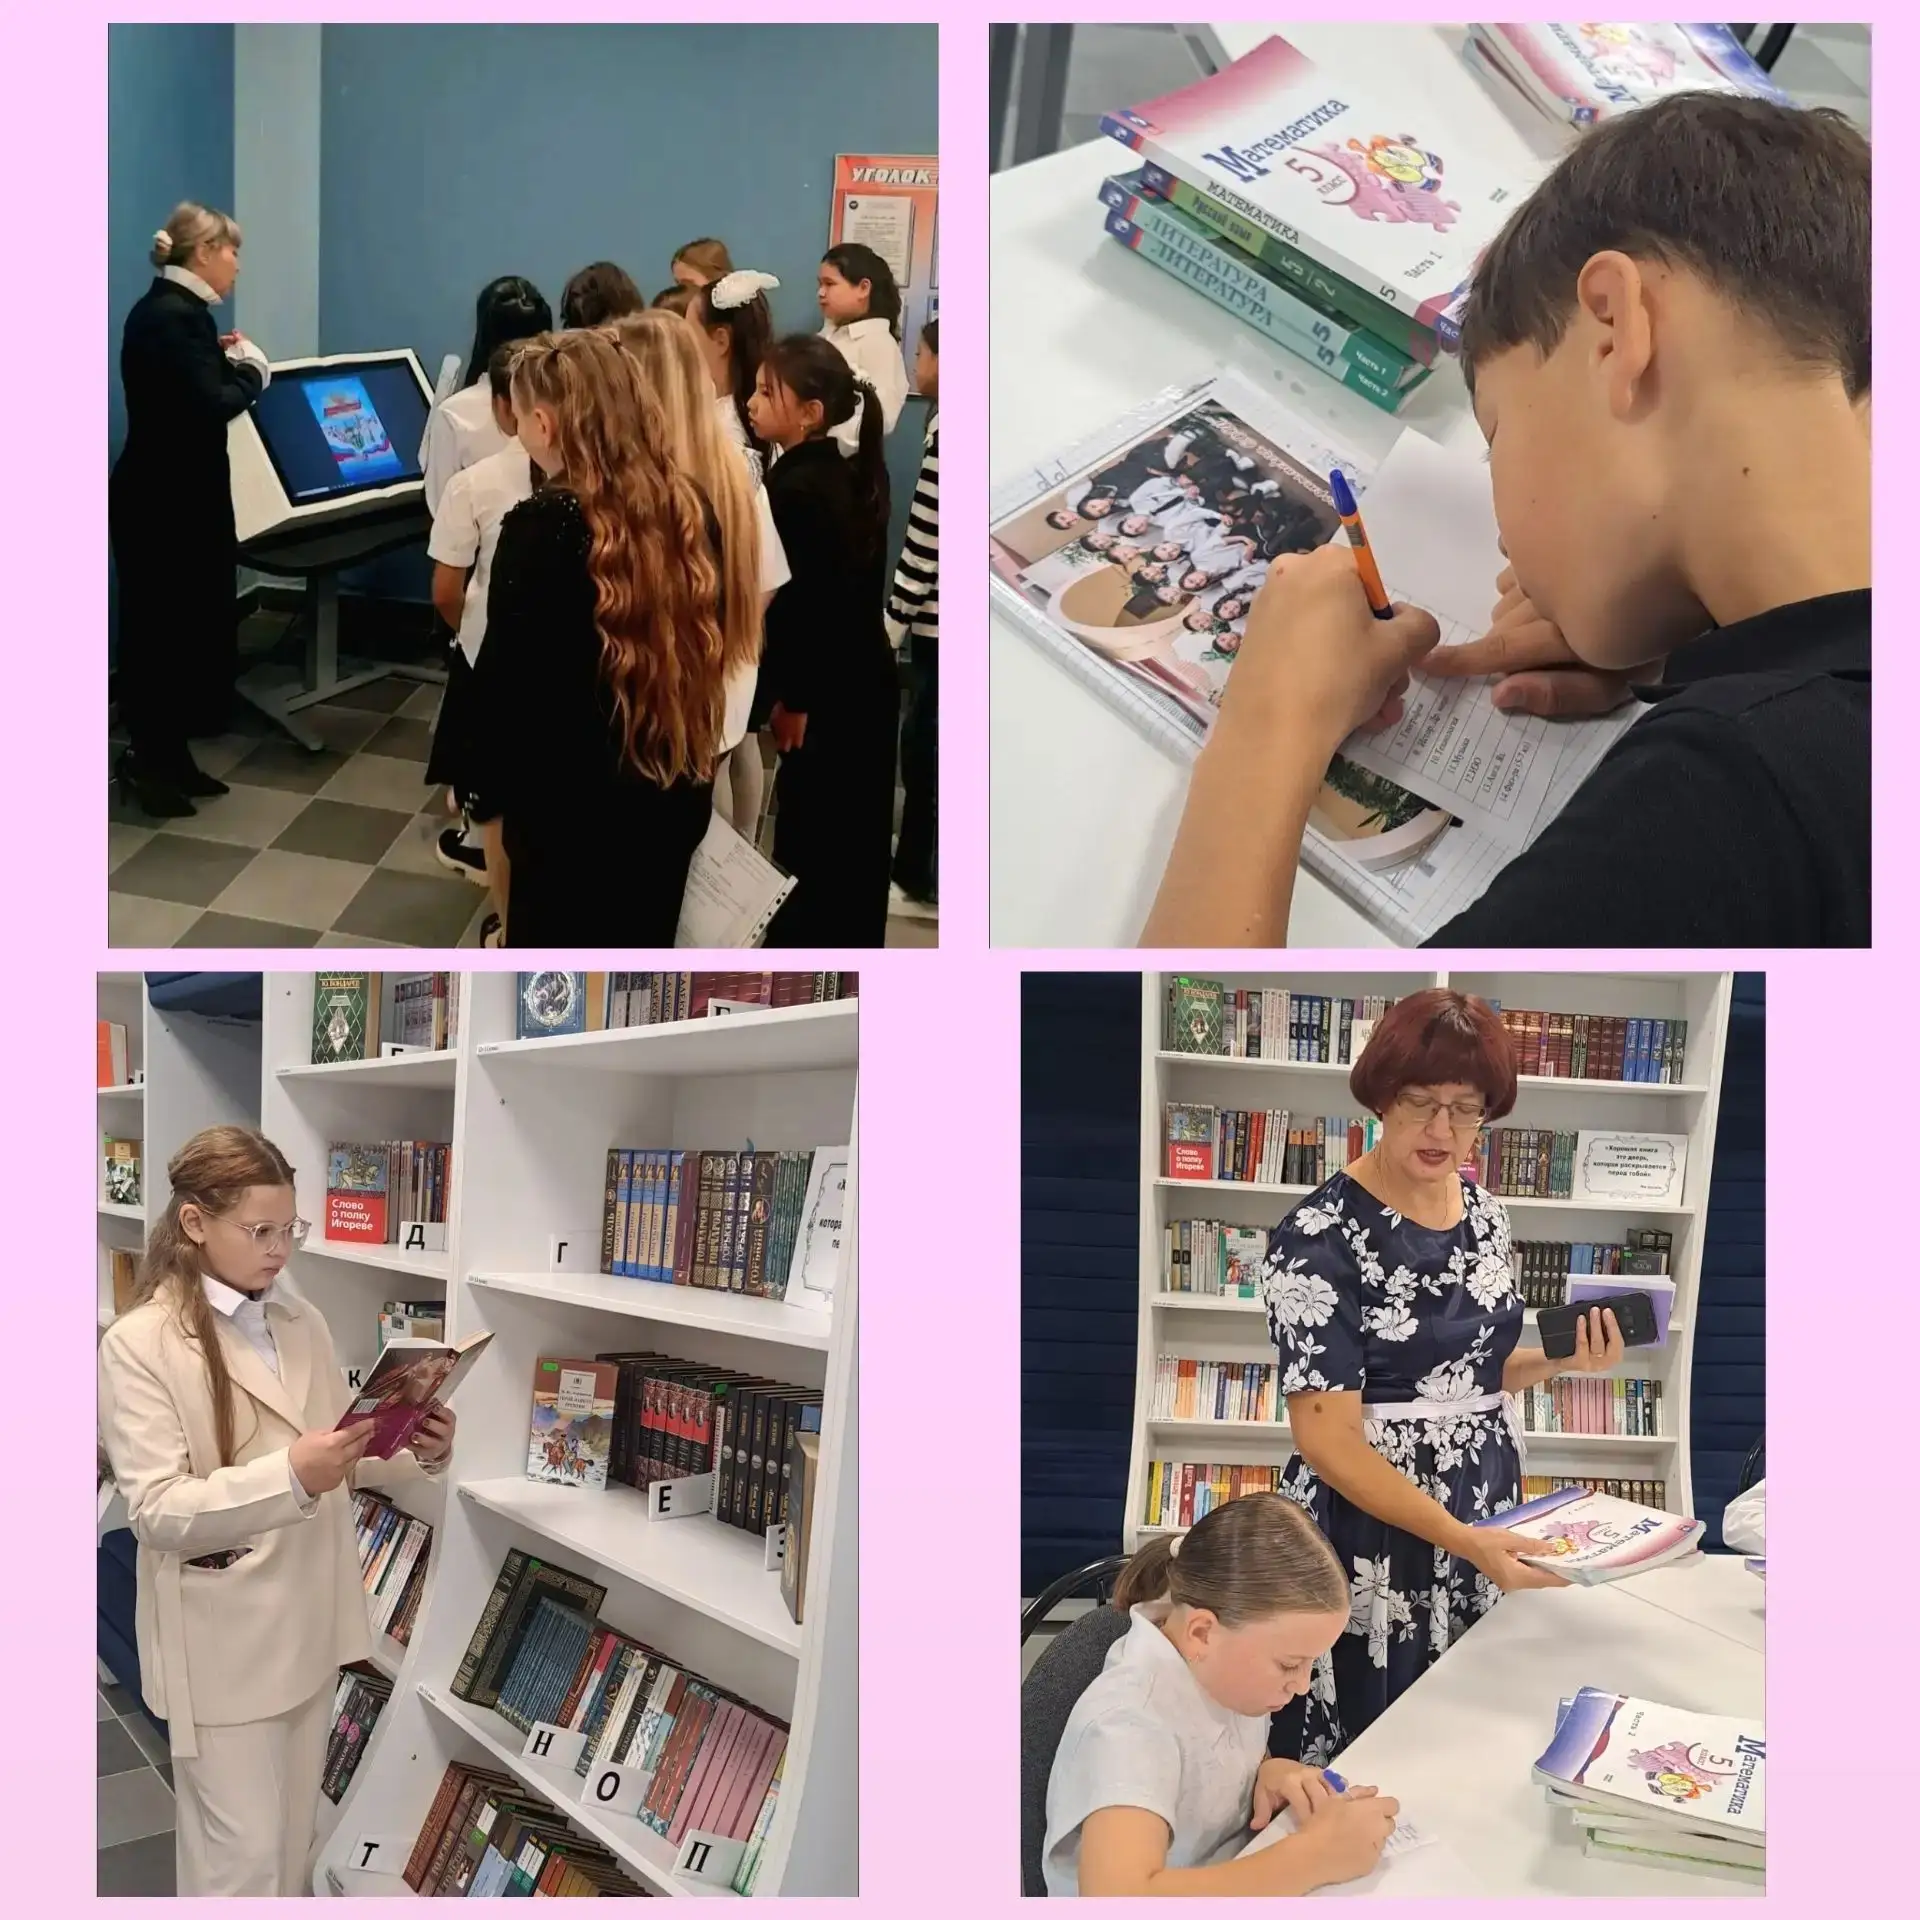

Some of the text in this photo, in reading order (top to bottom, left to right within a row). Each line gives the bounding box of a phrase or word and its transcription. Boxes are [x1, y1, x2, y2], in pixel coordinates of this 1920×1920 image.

[1201, 99, 1350, 184] Математика
[852, 167, 931, 185] УГОЛОК
[1285, 157, 1323, 183] 5
[1207, 181, 1397, 303] МАТЕМАТИКА 5
[1281, 255, 1303, 276] 5
[1144, 217, 1332, 343] ЛИТЕРАТУРА 5
[1151, 240, 1336, 367] ЛИТЕРАТУРА 5
[1440, 321, 1459, 339] Час
[1176, 1147, 1199, 1156] Слово
[1176, 1162, 1205, 1171] Игореве
[332, 1199, 364, 1211] Слово
[340, 1210, 371, 1222] полку
[331, 1219, 374, 1231] Игореве
[405, 1224, 425, 1250] Д
[556, 1242, 568, 1264] Г
[348, 1369, 361, 1389] К
[659, 1485, 672, 1513] Е
[1564, 1518, 1663, 1563] Математика
[1604, 1528, 1621, 1539] 5
[531, 1730, 556, 1757] Н
[1709, 1754, 1733, 1768] 5
[596, 1771, 620, 1802] О
[1726, 1735, 1766, 1815] Математика
[361, 1842, 380, 1867] Т
[683, 1840, 713, 1873] П
